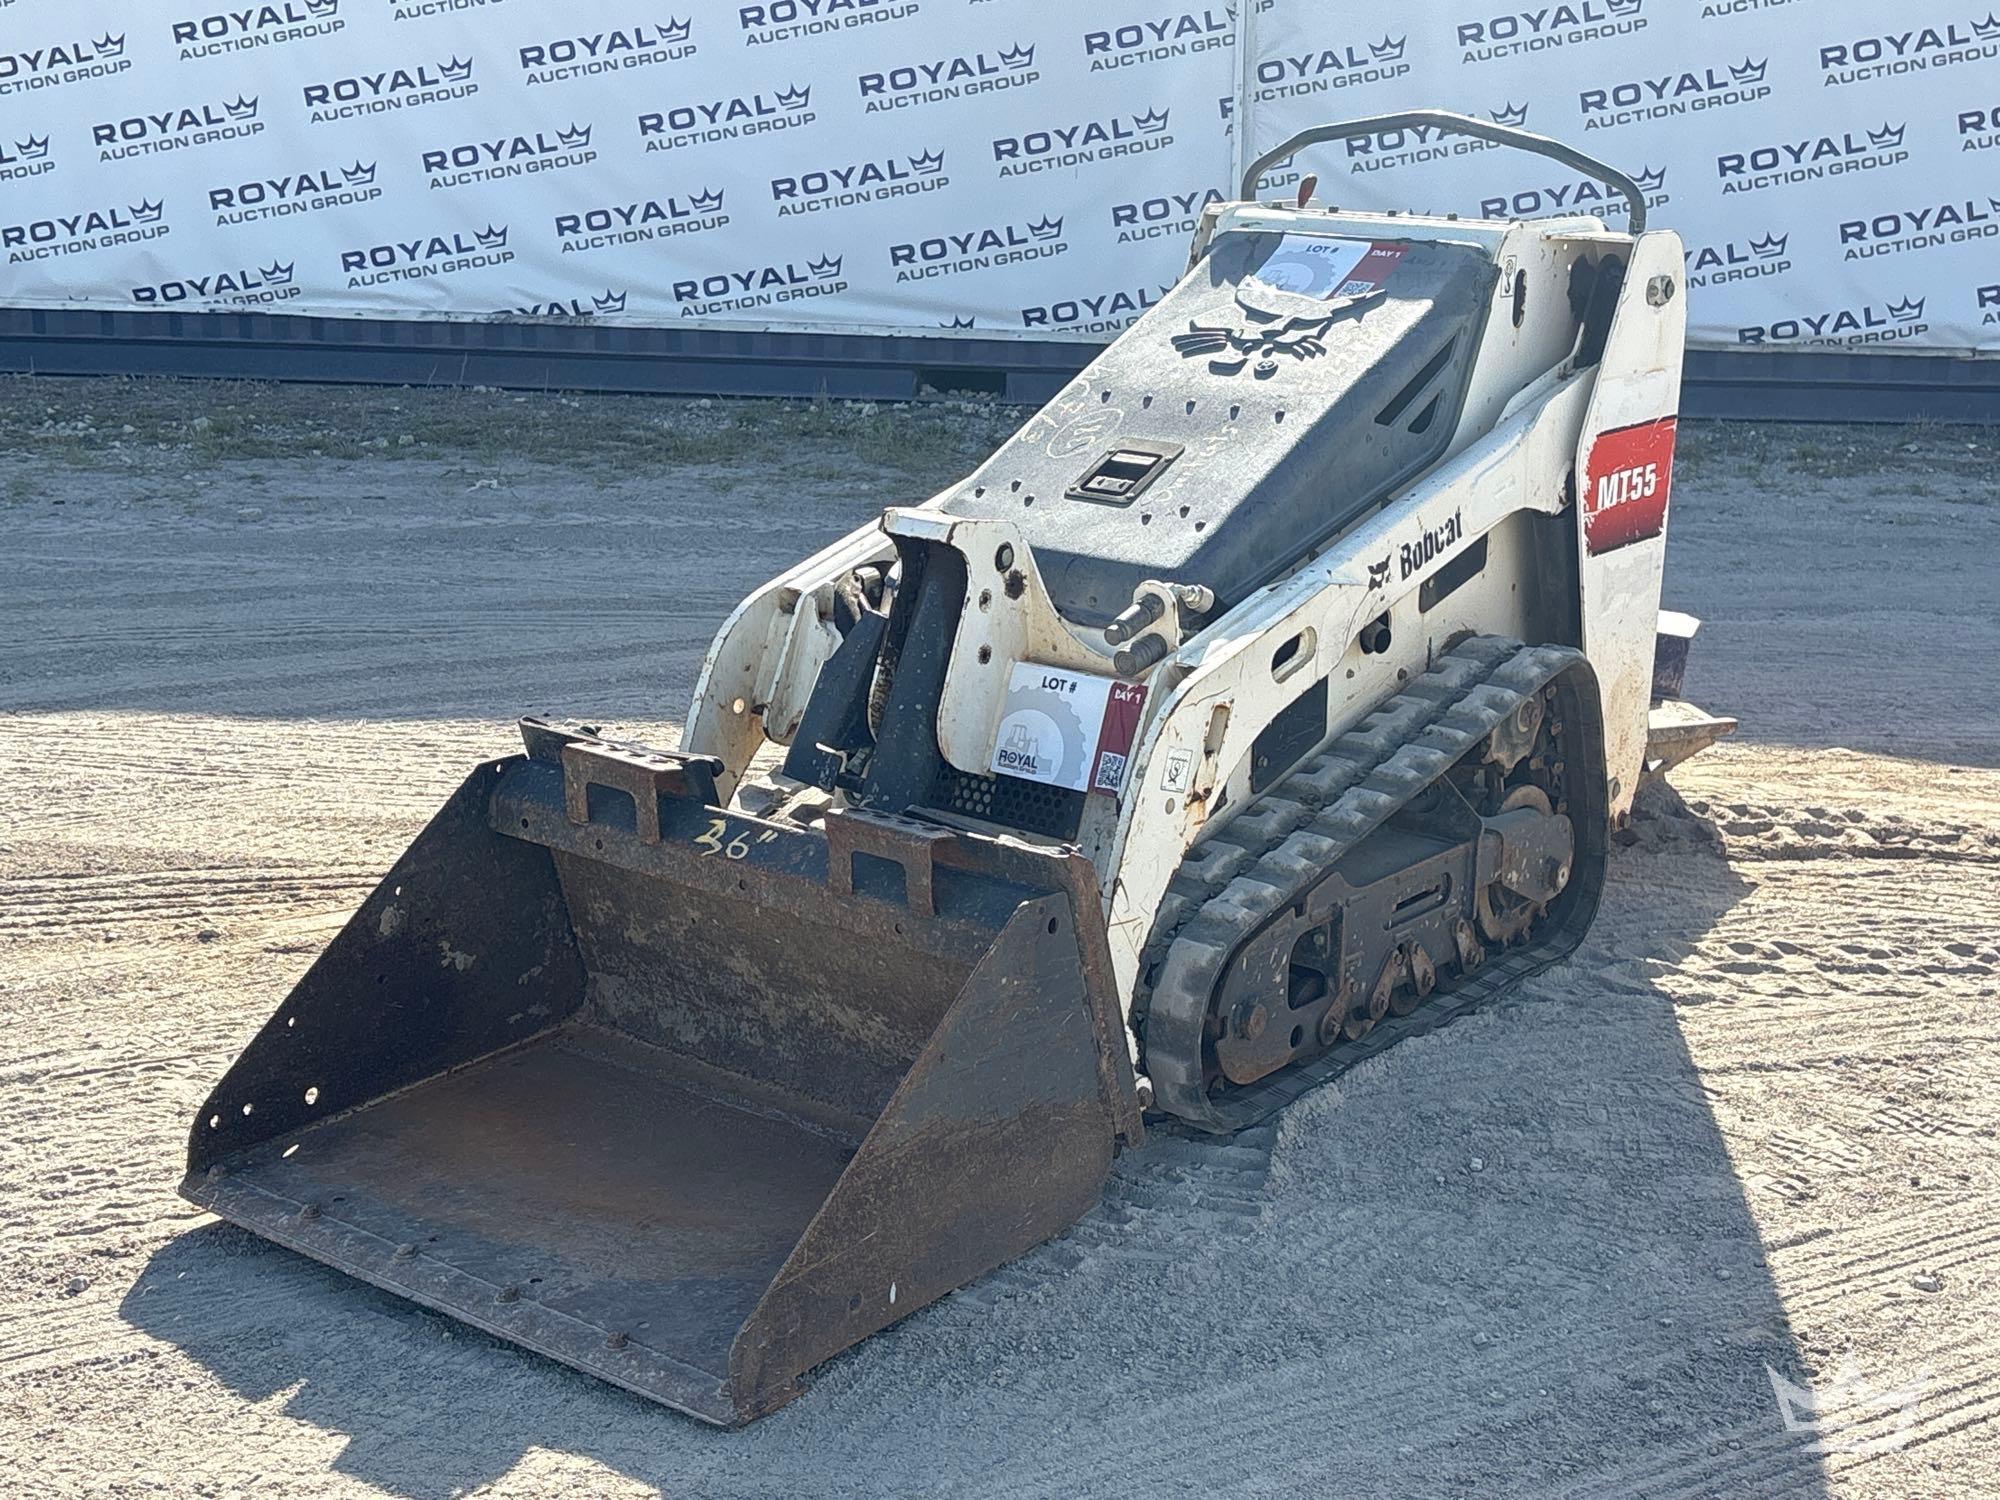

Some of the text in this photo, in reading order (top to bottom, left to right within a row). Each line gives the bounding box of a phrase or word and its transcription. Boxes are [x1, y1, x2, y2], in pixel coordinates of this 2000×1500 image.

[172, 3, 306, 44] ROYAL
[180, 20, 345, 60] AUCTION GROUP
[746, 4, 919, 46] AUCTION GROUP
[1085, 11, 1226, 55] ROYAL
[1458, 1, 1605, 46] ROYAL
[1463, 19, 1647, 64] AUCTION GROUP
[0, 43, 94, 78] OYAL
[520, 28, 657, 69] ROYAL
[527, 45, 696, 85] AUCTION GROUP
[1091, 34, 1235, 72] AUCTION GRO
[1258, 47, 1368, 83] OYAL
[1820, 25, 1970, 69] ROYAL
[1825, 45, 1997, 86] AUCTION GROU
[0, 60, 131, 94] CTION GROUP
[303, 67, 440, 107] ROYAL
[859, 54, 999, 97] ROYAL
[866, 72, 1039, 113] AUCTION GROUP
[1333, 64, 1410, 88] GROUP
[1580, 69, 1728, 113] ROYAL
[311, 84, 478, 123] AUCTION GROUP
[638, 95, 776, 136] ROYAL
[1585, 86, 1770, 131] AUCTION GROUP
[93, 105, 225, 146] ROYAL
[100, 123, 264, 162] AUCTION GROUP
[646, 113, 815, 152] AUCTION GROUP
[993, 119, 1133, 161] ROYAL
[0, 162, 55, 181] ROUP
[422, 134, 558, 173] ROYAL
[430, 151, 596, 189] AUCTION GROUP
[999, 136, 1173, 178] AUCTION GROUP
[1350, 140, 1500, 174] AUCTION GRO
[1718, 134, 1866, 177] ROYAL
[1723, 151, 1908, 194] AUCTION GROUP
[209, 171, 342, 210] ROYAL
[771, 160, 909, 200] ROYAL
[779, 177, 949, 217] AUCTION GROUP
[1256, 172, 1300, 190] OUP
[217, 188, 381, 226] AUCTION GROUP
[555, 198, 690, 237] ROYAL
[1112, 189, 1224, 227] ROYA
[1840, 201, 1988, 244] ROYAL
[2, 209, 130, 248] ROYAL
[9, 226, 169, 264] AUCTION GROUP
[562, 216, 729, 253] AUCTION GROUP
[890, 226, 1028, 266] ROYAL
[1117, 218, 1199, 243] AUCTIO
[1845, 224, 1998, 261] AUCTION GRO
[341, 234, 475, 272] ROYAL
[897, 243, 1067, 283] AUCTION GROUP
[1306, 245, 1329, 253] LOT
[1371, 250, 1393, 258] DAY
[132, 271, 262, 301] ROYAL
[348, 252, 514, 289] AUCTION GROUP
[673, 264, 808, 302] ROYAL
[1712, 261, 1791, 284] GROUP
[681, 282, 847, 317] AUCTION GROUP
[1022, 288, 1159, 327] ROYAL
[1738, 307, 1886, 344] ROYAL
[1848, 324, 1928, 345] GROUP
[1597, 463, 1656, 511] MT55
[1400, 506, 1463, 581] Bobcat
[1042, 676, 1077, 693] LOT #
[1114, 689, 1141, 704] DAY 1
[999, 749, 1037, 769] ROYAL
